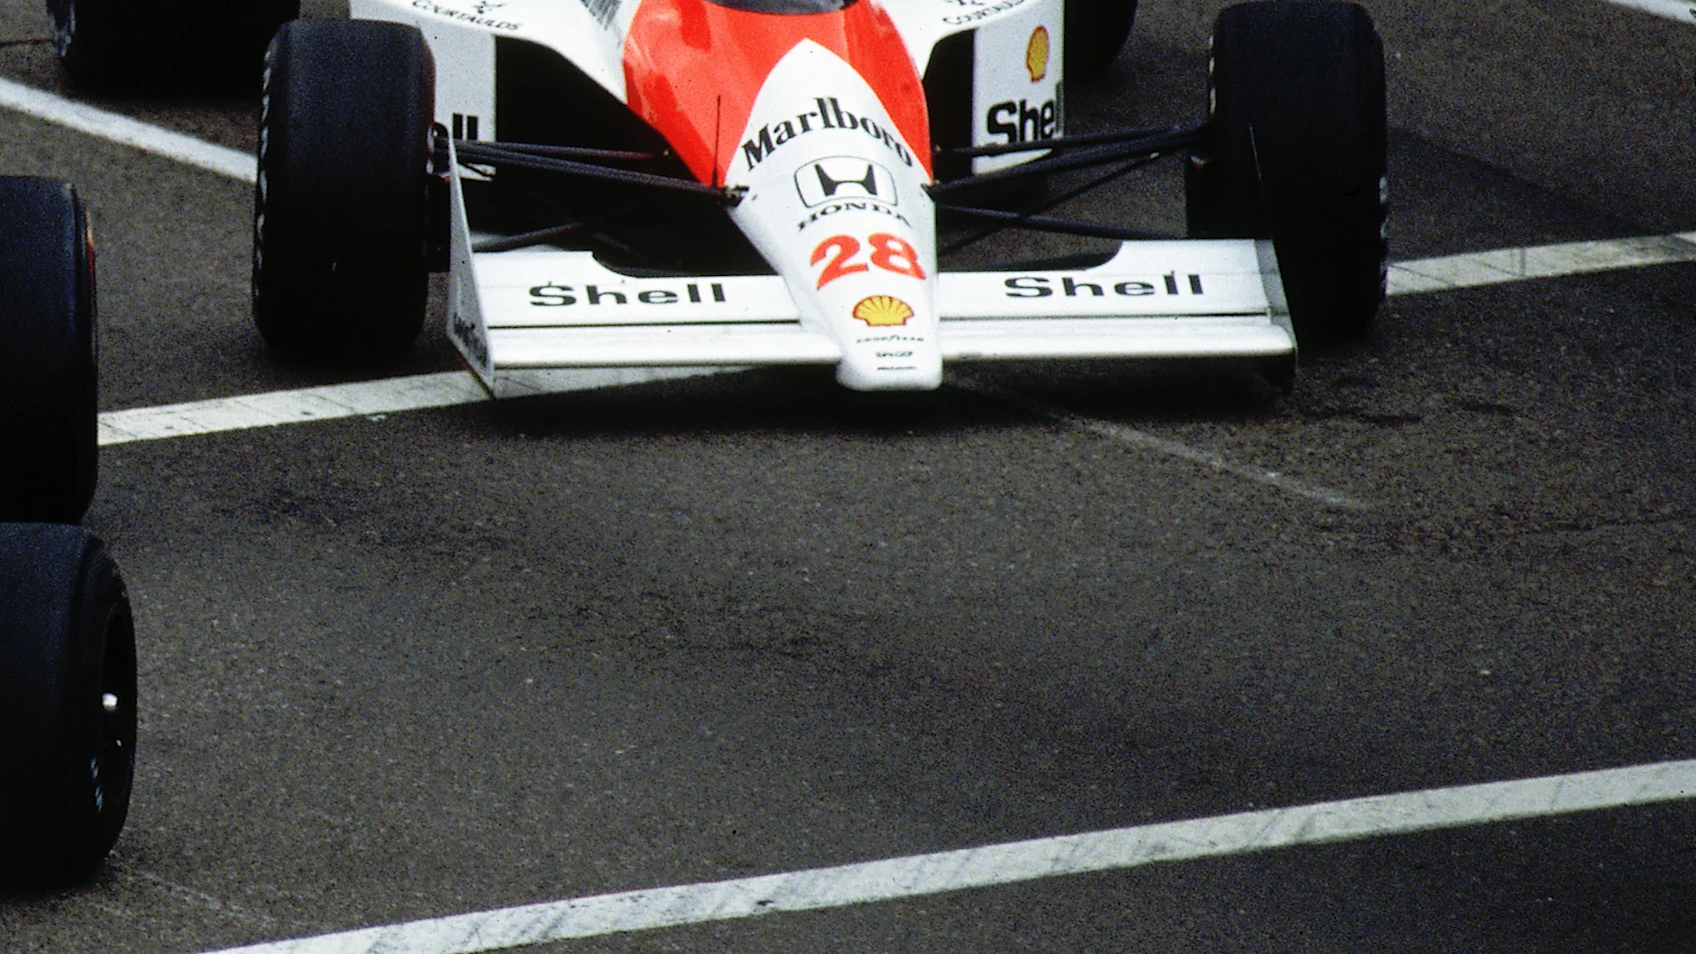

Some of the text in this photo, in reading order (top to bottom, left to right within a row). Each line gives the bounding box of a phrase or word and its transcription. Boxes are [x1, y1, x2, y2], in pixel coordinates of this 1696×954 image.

[741, 96, 913, 171] Marlboro
[798, 202, 911, 232] HONDA
[810, 232, 926, 290] 28
[529, 283, 726, 306] Shell
[1003, 274, 1204, 297] Shell
